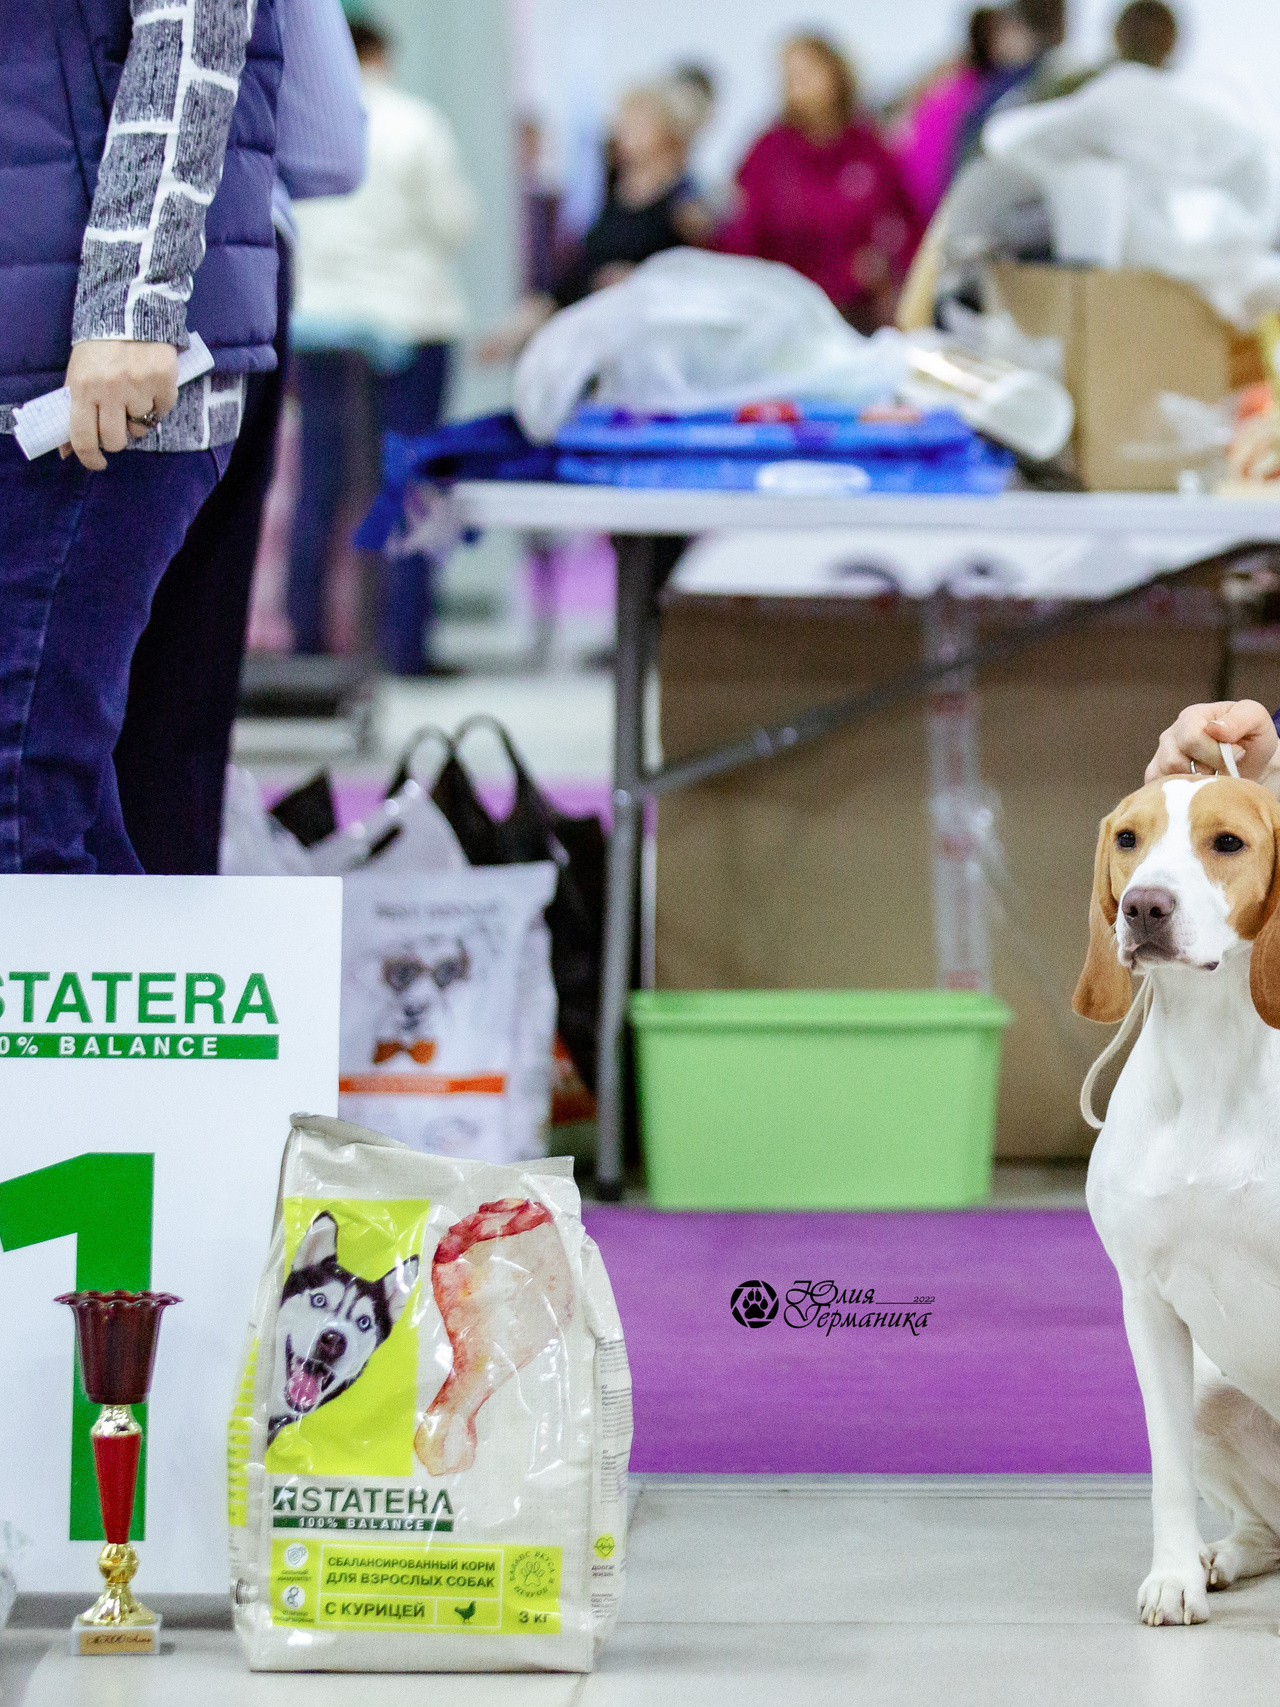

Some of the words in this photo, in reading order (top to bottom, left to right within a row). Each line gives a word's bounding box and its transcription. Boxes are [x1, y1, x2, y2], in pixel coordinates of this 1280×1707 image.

[0, 971, 279, 1024] TATERA
[58, 1036, 218, 1057] BALANCE
[0, 1152, 155, 1541] 1
[301, 1486, 455, 1514] STATERA
[299, 1517, 338, 1528] 100%
[347, 1518, 425, 1530] BALANCE
[327, 1556, 458, 1571] СБАЛАНСИРОВАННЫЙ
[461, 1561, 496, 1571] КОРМ
[326, 1572, 357, 1585] ДЛЯ
[361, 1573, 443, 1587] ВЗРОСЛЫХ
[446, 1576, 496, 1588] СОБАК
[341, 1602, 425, 1620] КУРИЦЕЙ
[518, 1611, 530, 1624] 3
